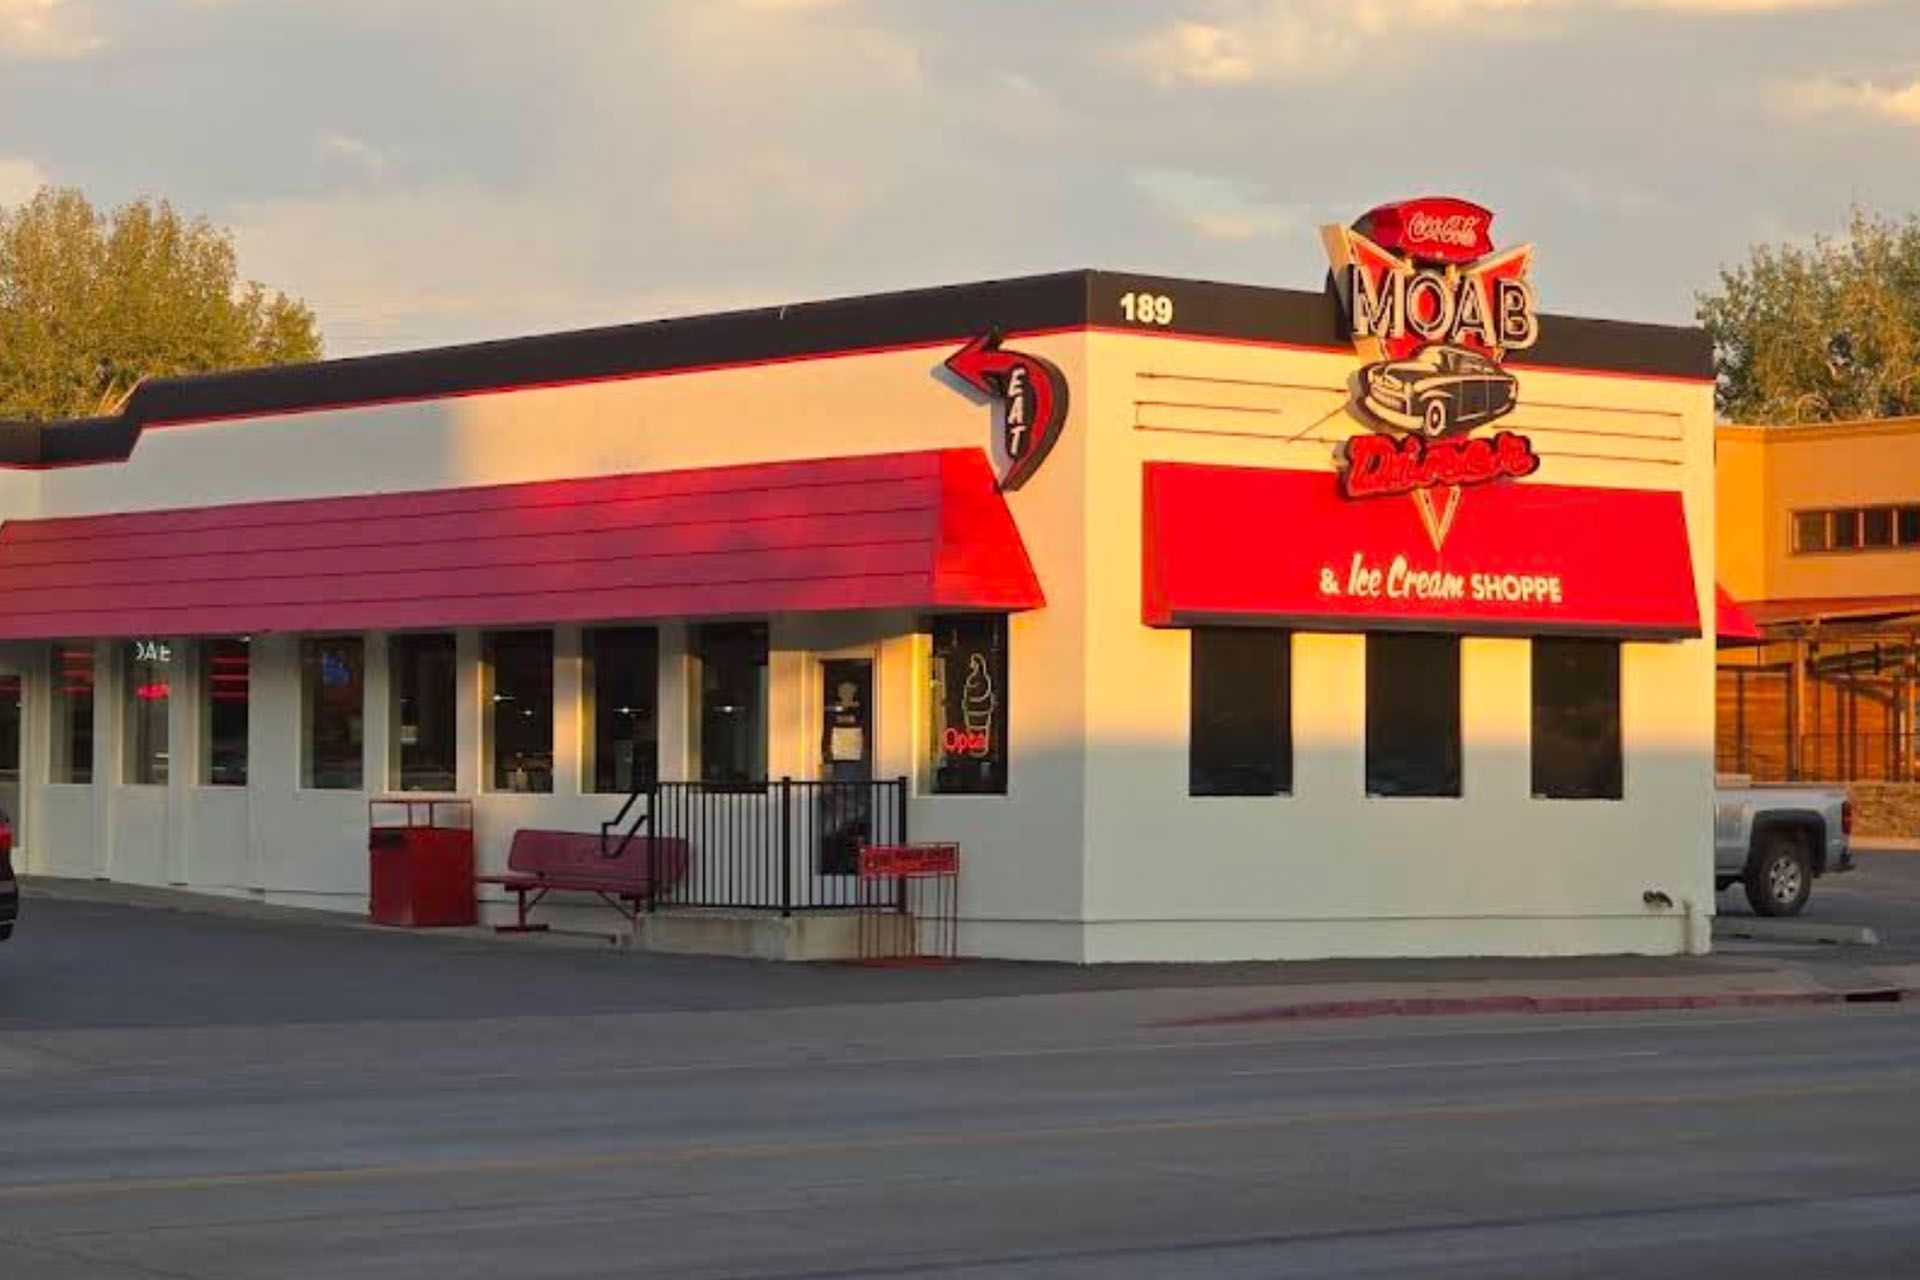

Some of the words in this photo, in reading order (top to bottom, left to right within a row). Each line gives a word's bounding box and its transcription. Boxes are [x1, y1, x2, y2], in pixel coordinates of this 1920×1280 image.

[1120, 292, 1173, 325] 189
[1352, 265, 1539, 348] MOAB
[1007, 366, 1027, 455] EAT
[1347, 434, 1537, 497] Diner
[1320, 567, 1341, 594] &
[1348, 552, 1382, 597] Ice
[1386, 554, 1466, 599] Cream
[1471, 573, 1562, 603] SHOPPE
[943, 727, 988, 754] Open
